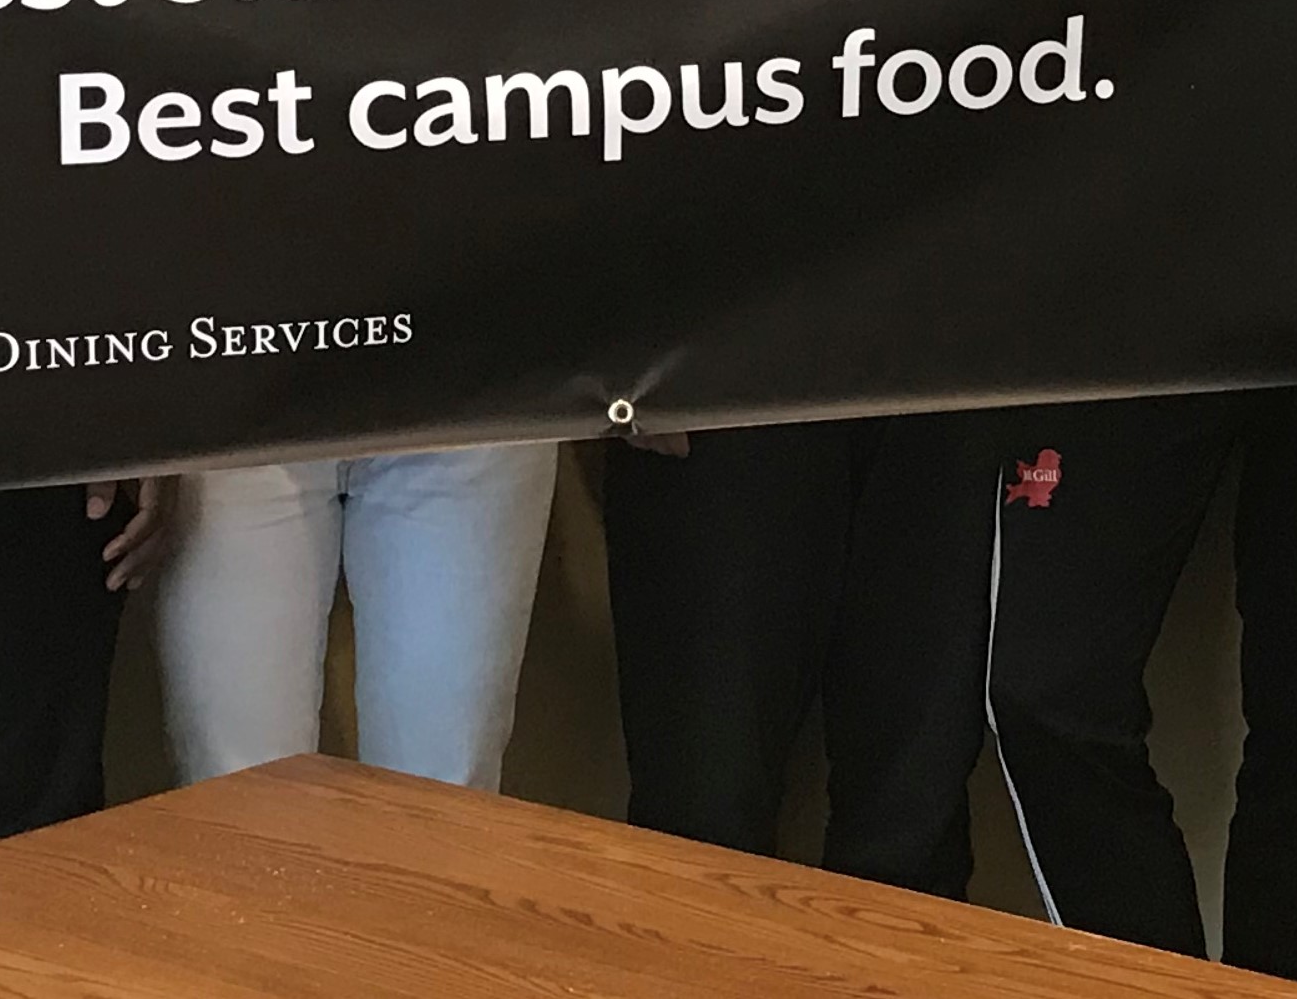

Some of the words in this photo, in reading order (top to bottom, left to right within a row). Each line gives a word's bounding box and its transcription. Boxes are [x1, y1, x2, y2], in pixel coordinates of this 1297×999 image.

[59, 68, 315, 166] Best
[348, 56, 805, 162] campus
[831, 14, 1115, 118] food.
[189, 312, 414, 359] SERVICES
